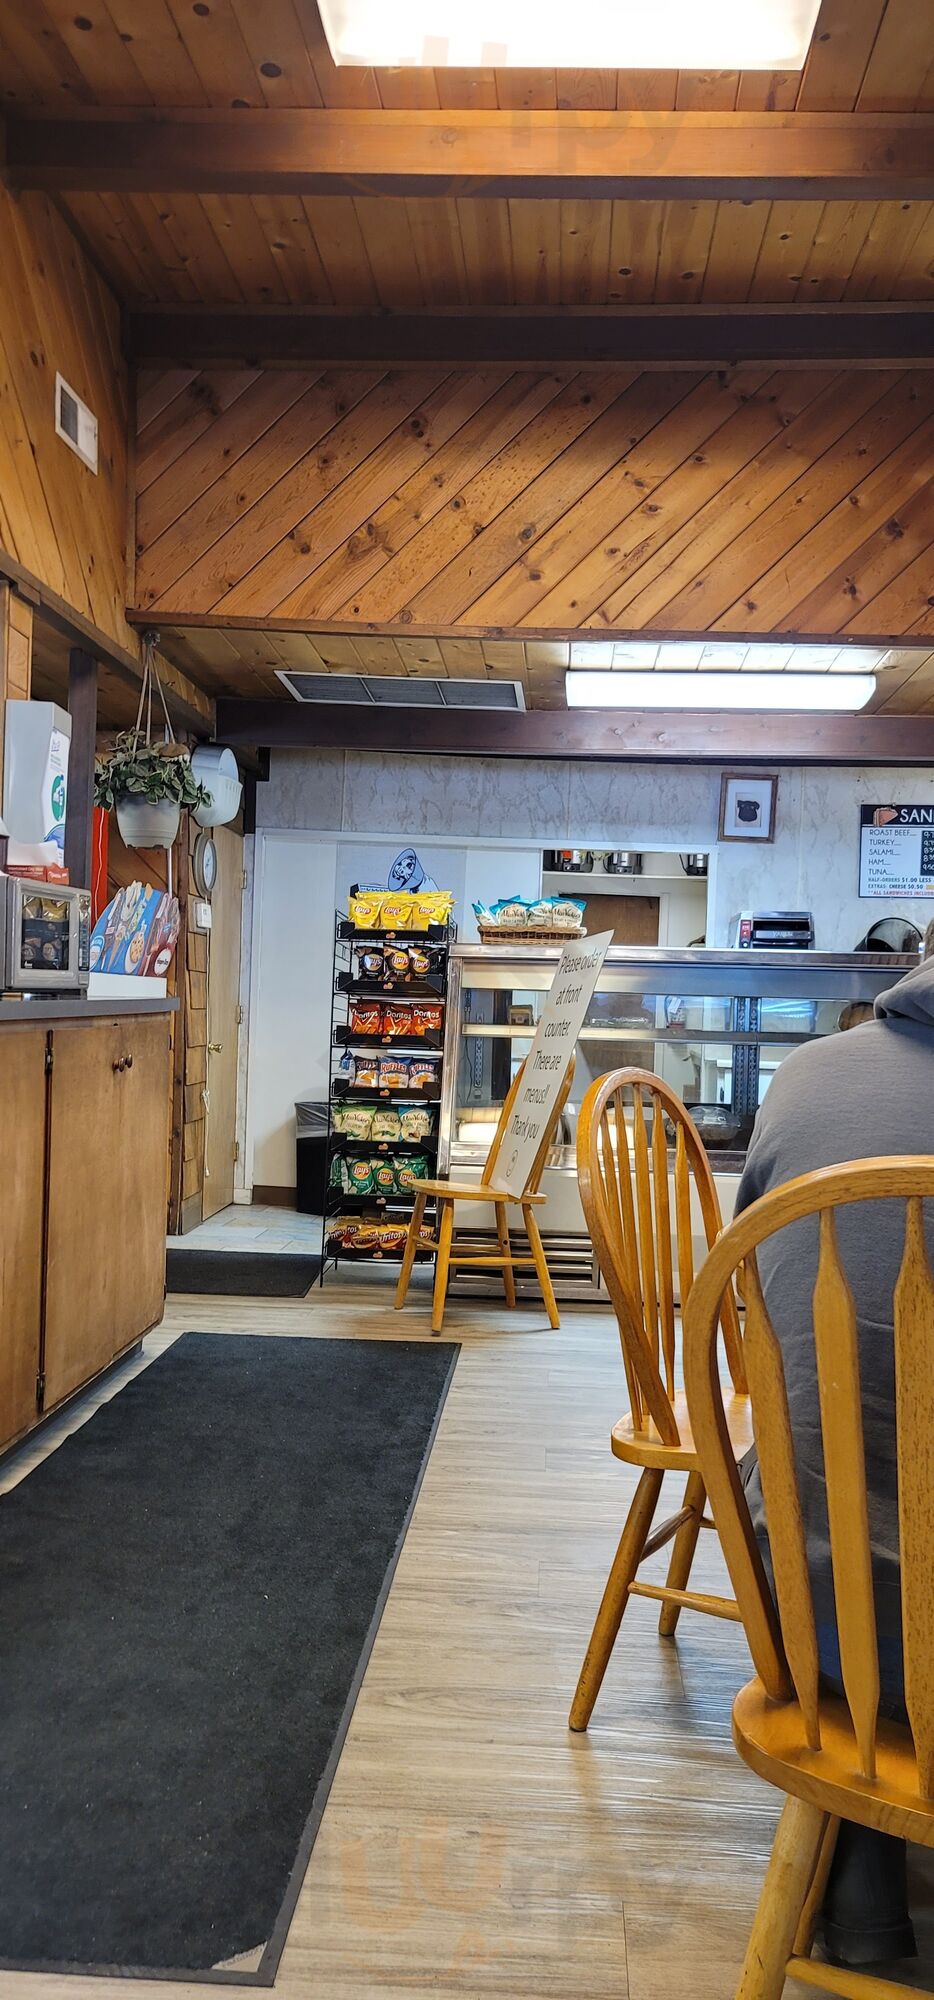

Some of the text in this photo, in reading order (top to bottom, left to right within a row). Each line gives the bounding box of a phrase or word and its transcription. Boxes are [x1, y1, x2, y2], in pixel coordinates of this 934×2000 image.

[559, 948, 602, 975] Please order
[564, 984, 583, 1005] front
[386, 1010, 412, 1020] Doritos
[413, 1009, 440, 1018] Doritos
[533, 1050, 562, 1070] There are
[511, 1114, 540, 1143] Thank you
